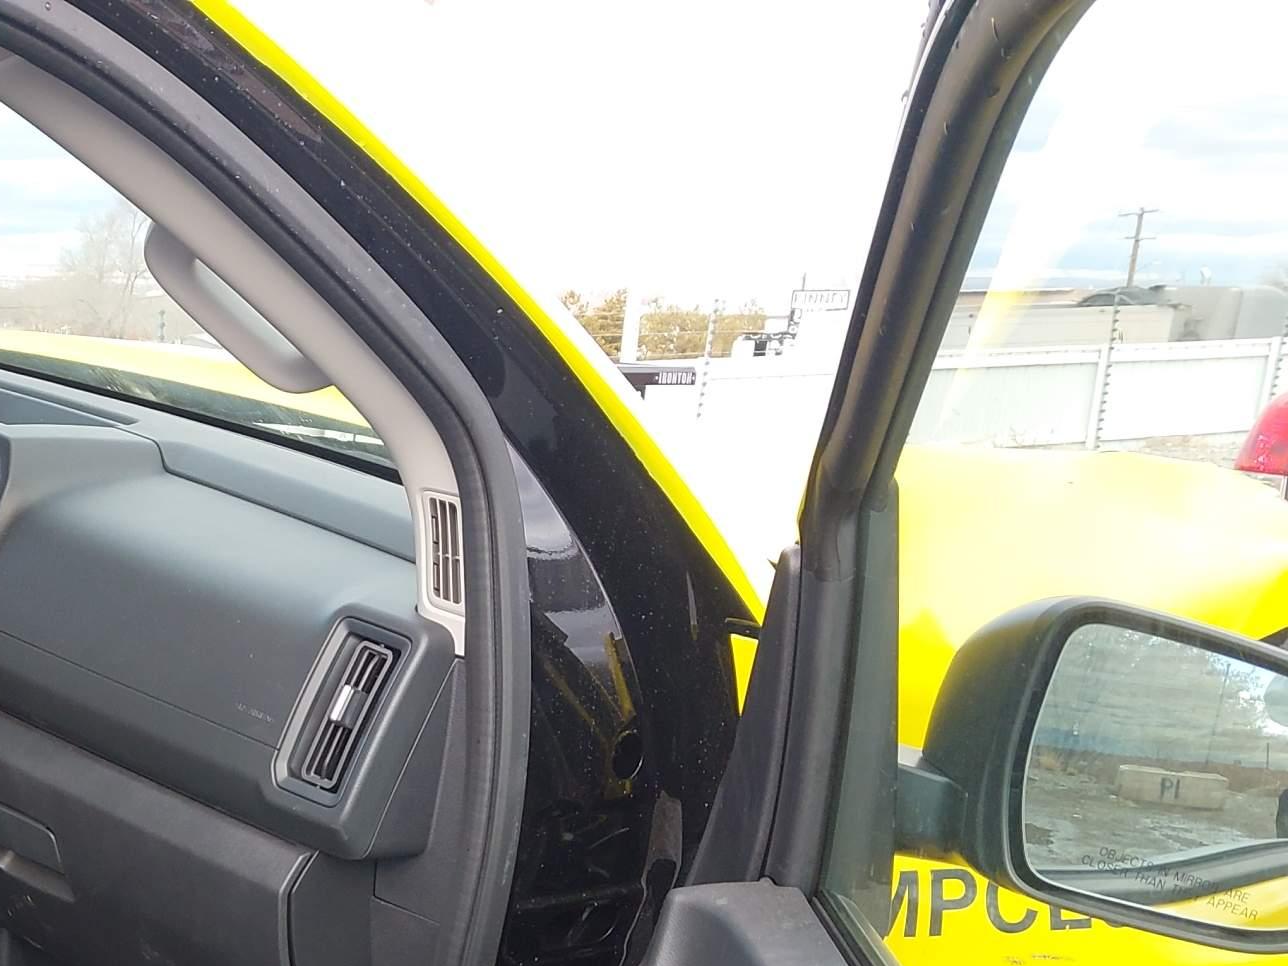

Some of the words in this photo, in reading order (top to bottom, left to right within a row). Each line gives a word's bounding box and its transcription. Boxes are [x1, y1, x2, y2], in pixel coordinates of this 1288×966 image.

[1081, 855, 1128, 879] CLOSER
[1134, 869, 1167, 889] THAN
[1206, 896, 1258, 921] APPEAR
[1099, 846, 1154, 868] OBJECTS
[1157, 866, 1171, 879] IN
[1224, 887, 1251, 904] ARE
